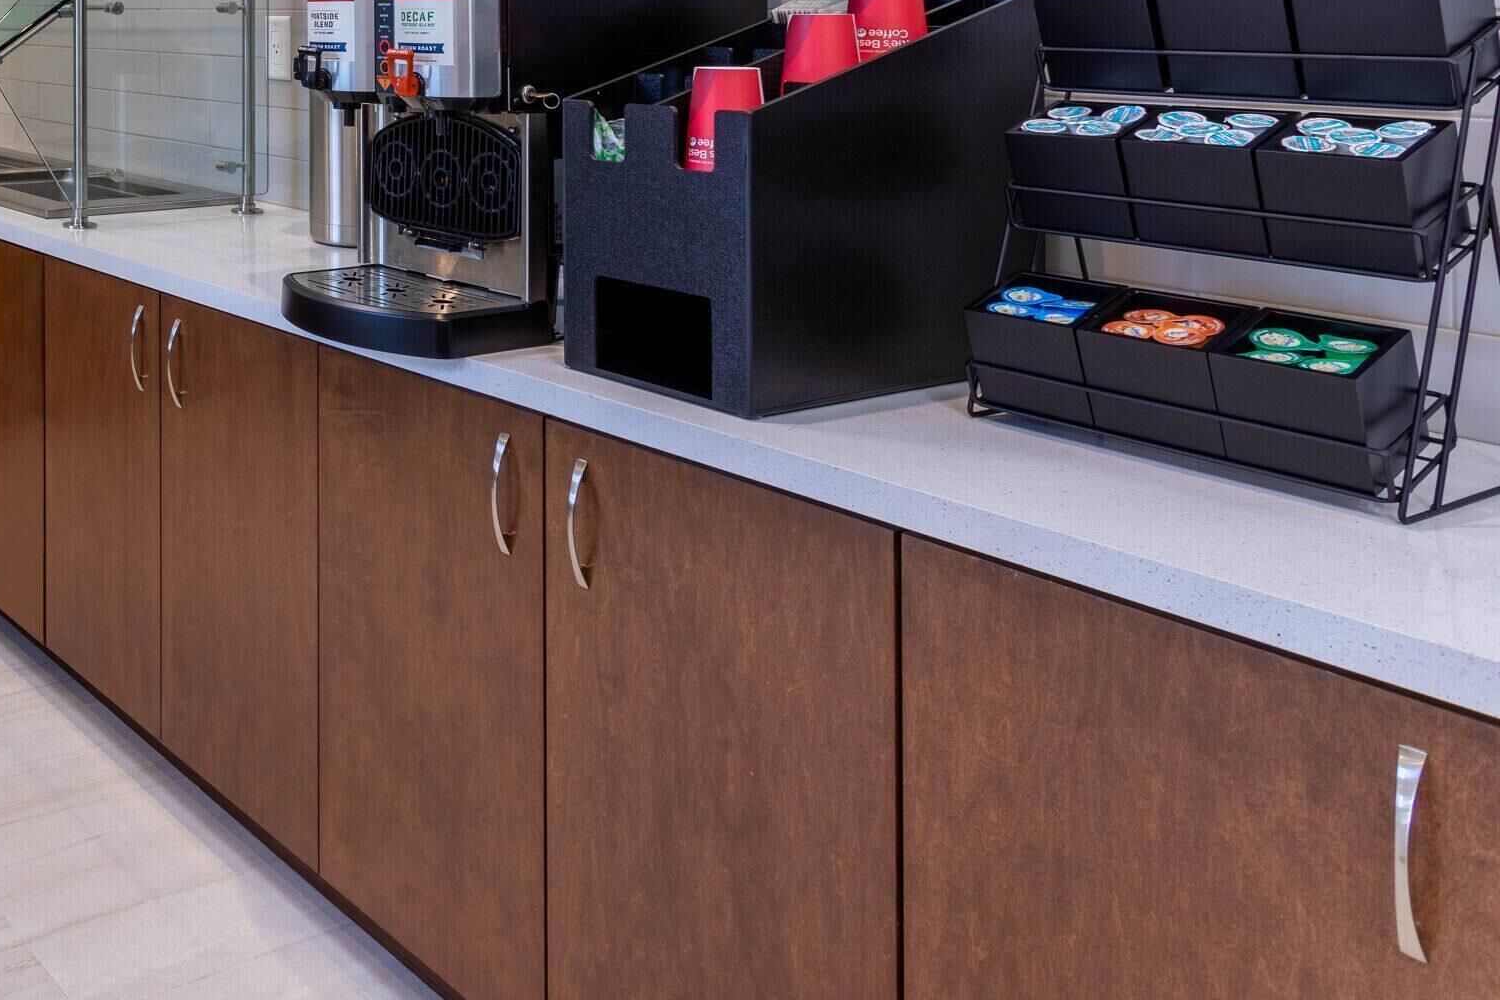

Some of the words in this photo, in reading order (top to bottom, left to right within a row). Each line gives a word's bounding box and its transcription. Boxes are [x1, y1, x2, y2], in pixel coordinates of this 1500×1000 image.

[311, 12, 339, 20] PORTSIDE
[401, 11, 434, 22] DECAF
[869, 29, 909, 39] Coffee
[858, 40, 880, 49] Bes
[697, 138, 714, 149] fee
